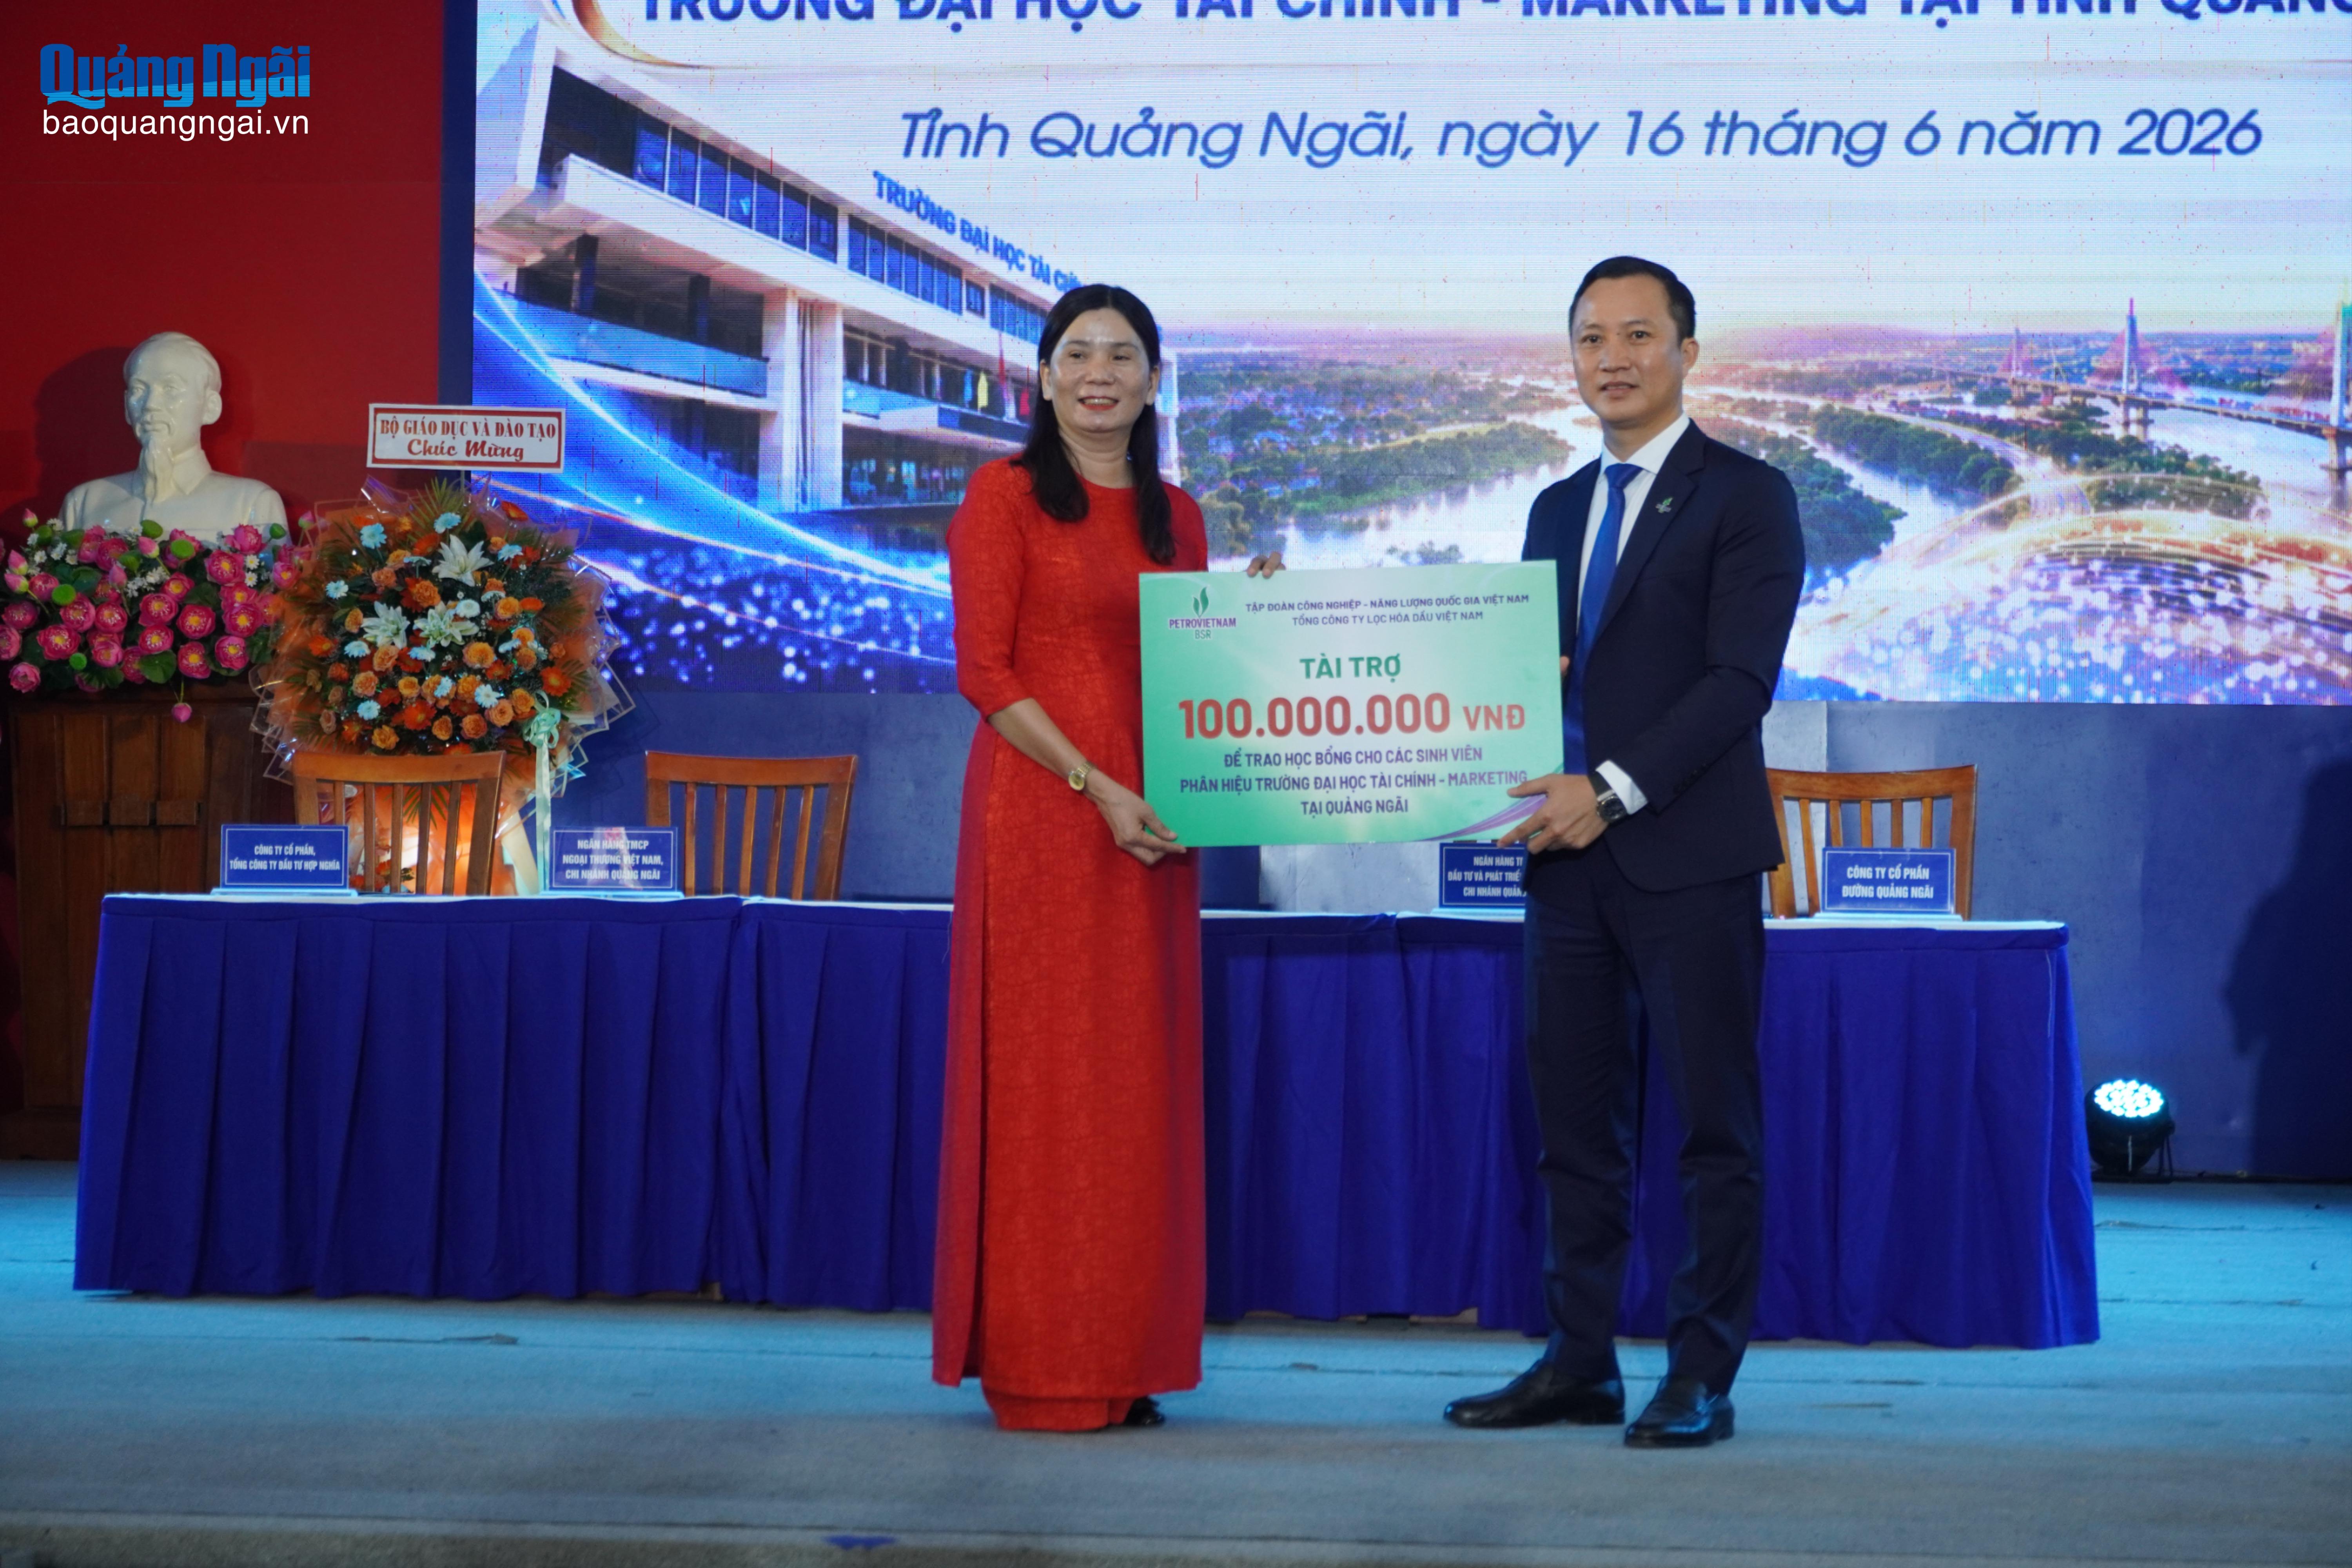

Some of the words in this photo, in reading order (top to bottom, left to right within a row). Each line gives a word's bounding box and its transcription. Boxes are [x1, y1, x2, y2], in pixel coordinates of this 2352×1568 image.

[902, 107, 1010, 158] Tỉnh
[1030, 106, 1243, 169] Quảng
[1259, 111, 1414, 169] Ngãi,
[1437, 109, 1600, 168] ngày
[1626, 109, 1685, 157] 16
[1704, 108, 1887, 168] tháng
[1904, 109, 1941, 156] 6
[1957, 109, 2102, 156] năm
[2118, 108, 2263, 156] 2026
[380, 416, 399, 438] BỘ
[403, 416, 437, 436] GIÁO
[441, 421, 468, 439] DỤC
[473, 418, 490, 437] VÀ
[495, 419, 524, 437] ĐÀO
[527, 423, 555, 442] TẠO
[408, 439, 457, 456] Chúc
[465, 440, 524, 461] Mừng
[1246, 602, 1265, 614] TẬP
[1267, 600, 1294, 612] ĐOÀN
[1297, 600, 1323, 610] CÔNG
[1326, 599, 1361, 611] NGHIỆP
[1370, 598, 1397, 608] NĂNG
[1401, 597, 1433, 609] LƯỢNG
[1436, 595, 1461, 606] QUỐC
[1464, 595, 1480, 605] GIA
[1483, 593, 1504, 606] VIỆT
[1507, 594, 1529, 603] NAM
[1169, 618, 1236, 628] PETROVIETNAM
[1292, 614, 1319, 626] TỔNG
[1322, 615, 1349, 624] CÔNG
[1352, 615, 1365, 624] TY
[1367, 615, 1387, 625] LỌC
[1389, 613, 1410, 622] HÓA
[1413, 610, 1433, 622] DẦU
[1436, 610, 1458, 621] VIỆT
[1461, 612, 1483, 620] NAM
[1195, 630, 1211, 639] BSR
[1299, 653, 1341, 679] TÀI
[1349, 653, 1401, 682] TRỢ
[1178, 692, 1450, 740] 100.000.000
[1462, 704, 1525, 731] VNĐ
[1224, 747, 1242, 768] ĐỂ
[1245, 753, 1281, 767] TRAO
[1285, 752, 1312, 769] HỌC
[1315, 745, 1352, 766] BỔNG
[1356, 751, 1382, 764] CHO
[1386, 747, 1413, 764] CÁC
[1416, 748, 1448, 763] SINH
[1451, 744, 1482, 761] VIÊN
[1180, 776, 1218, 793] PHÂN
[1221, 775, 1252, 796] HIỆU
[1255, 774, 1310, 791] TRƯỜNG
[1314, 777, 1336, 793] ĐẠI
[1339, 775, 1367, 793] HỌC
[1370, 772, 1391, 789] TÀI
[1395, 771, 1436, 788] CHÍNH
[1448, 770, 1528, 786] MARKETING
[1301, 801, 1322, 818] TẠI
[1326, 796, 1372, 815] QUẢNG
[1376, 796, 1408, 813] NGÃI
[254, 844, 273, 855] CÔNG
[274, 846, 283, 855] TY
[577, 839, 600, 849] NGÂN
[627, 840, 649, 850] TMCP
[249, 859, 267, 870] CÔNG
[269, 861, 277, 870] TY
[563, 855, 588, 866] NGOẠI
[623, 855, 640, 866] VIỆT
[642, 855, 663, 866] NAM,
[1474, 855, 1493, 866] NGÂN
[1495, 855, 1514, 866] HÀNG
[566, 870, 579, 879] CHI
[581, 869, 609, 879] NHÁNH
[1474, 870, 1484, 881] VÀ
[1485, 871, 1503, 881] PHÁT
[1847, 865, 1873, 879] CÔNG
[1875, 867, 1886, 879] TY
[1463, 887, 1475, 897] CHI
[1477, 886, 1501, 897] NHÁNH
[1503, 885, 1526, 898] QUẢN
[1842, 884, 1874, 898] ĐƯỜNG
[1877, 883, 1909, 899] QUẢNG
[1911, 885, 1934, 898] NGÃI
